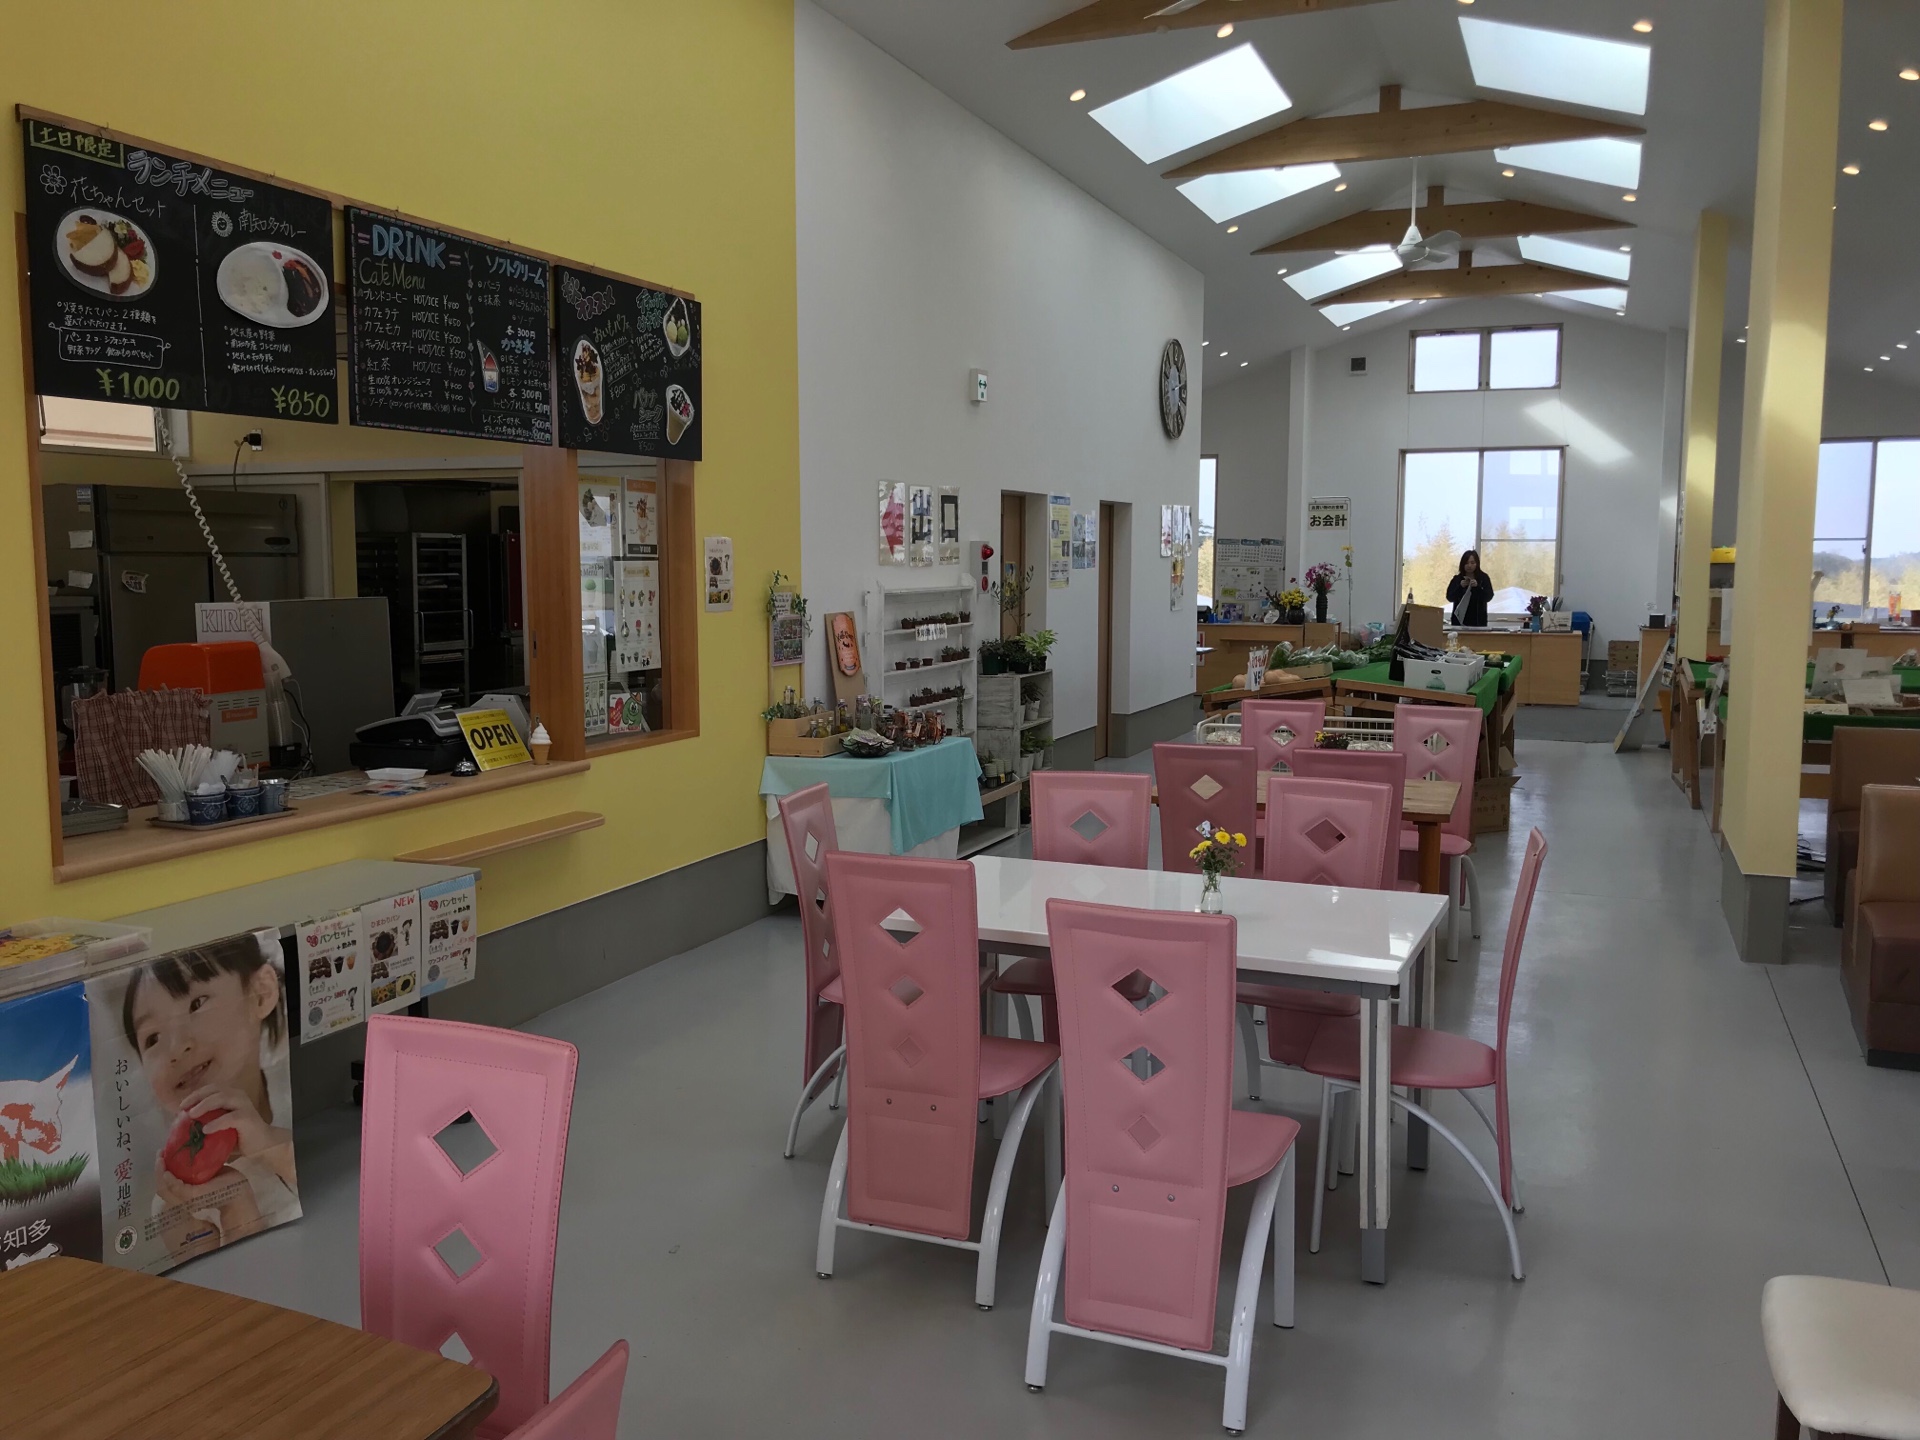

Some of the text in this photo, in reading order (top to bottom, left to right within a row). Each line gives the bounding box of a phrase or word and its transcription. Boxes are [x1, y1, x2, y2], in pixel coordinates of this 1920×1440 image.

[40, 127, 115, 158] 土日限定
[127, 150, 254, 203] ランチメニュー
[70, 176, 166, 218] 花ちゃんセット
[238, 208, 307, 238] 南知多カレー
[372, 223, 447, 270] DRINK
[391, 262, 426, 290] Menu
[486, 255, 545, 288] ソフトクリーム
[483, 280, 501, 292] バニラ
[413, 294, 439, 308] HOT/ICE
[574, 285, 616, 321] オススメ
[364, 306, 400, 322] カフェラテ
[411, 311, 440, 325] HOT/ICE
[364, 320, 401, 337] カフェモカ
[411, 329, 441, 342] HOT/ICE
[517, 327, 536, 340] 300円
[500, 338, 536, 355] かき氷
[366, 356, 391, 372] 紅茶
[412, 361, 442, 375] HOT/ICE
[270, 385, 330, 418] ¥850
[521, 388, 543, 401] 300円
[534, 402, 551, 415] 50円
[531, 418, 552, 433] 500円
[1309, 514, 1347, 527] お会計
[200, 608, 264, 633] KIRIN
[470, 723, 519, 750] OPEN
[393, 894, 415, 910] NEW
[439, 893, 469, 909] パンセット
[370, 914, 401, 929] ひまわりパン
[319, 927, 354, 945] パンセット
[308, 995, 333, 1008] ワンコイン
[114, 1058, 134, 1220] おいしいね、愛地産
[0, 1218, 52, 1252] 知多
